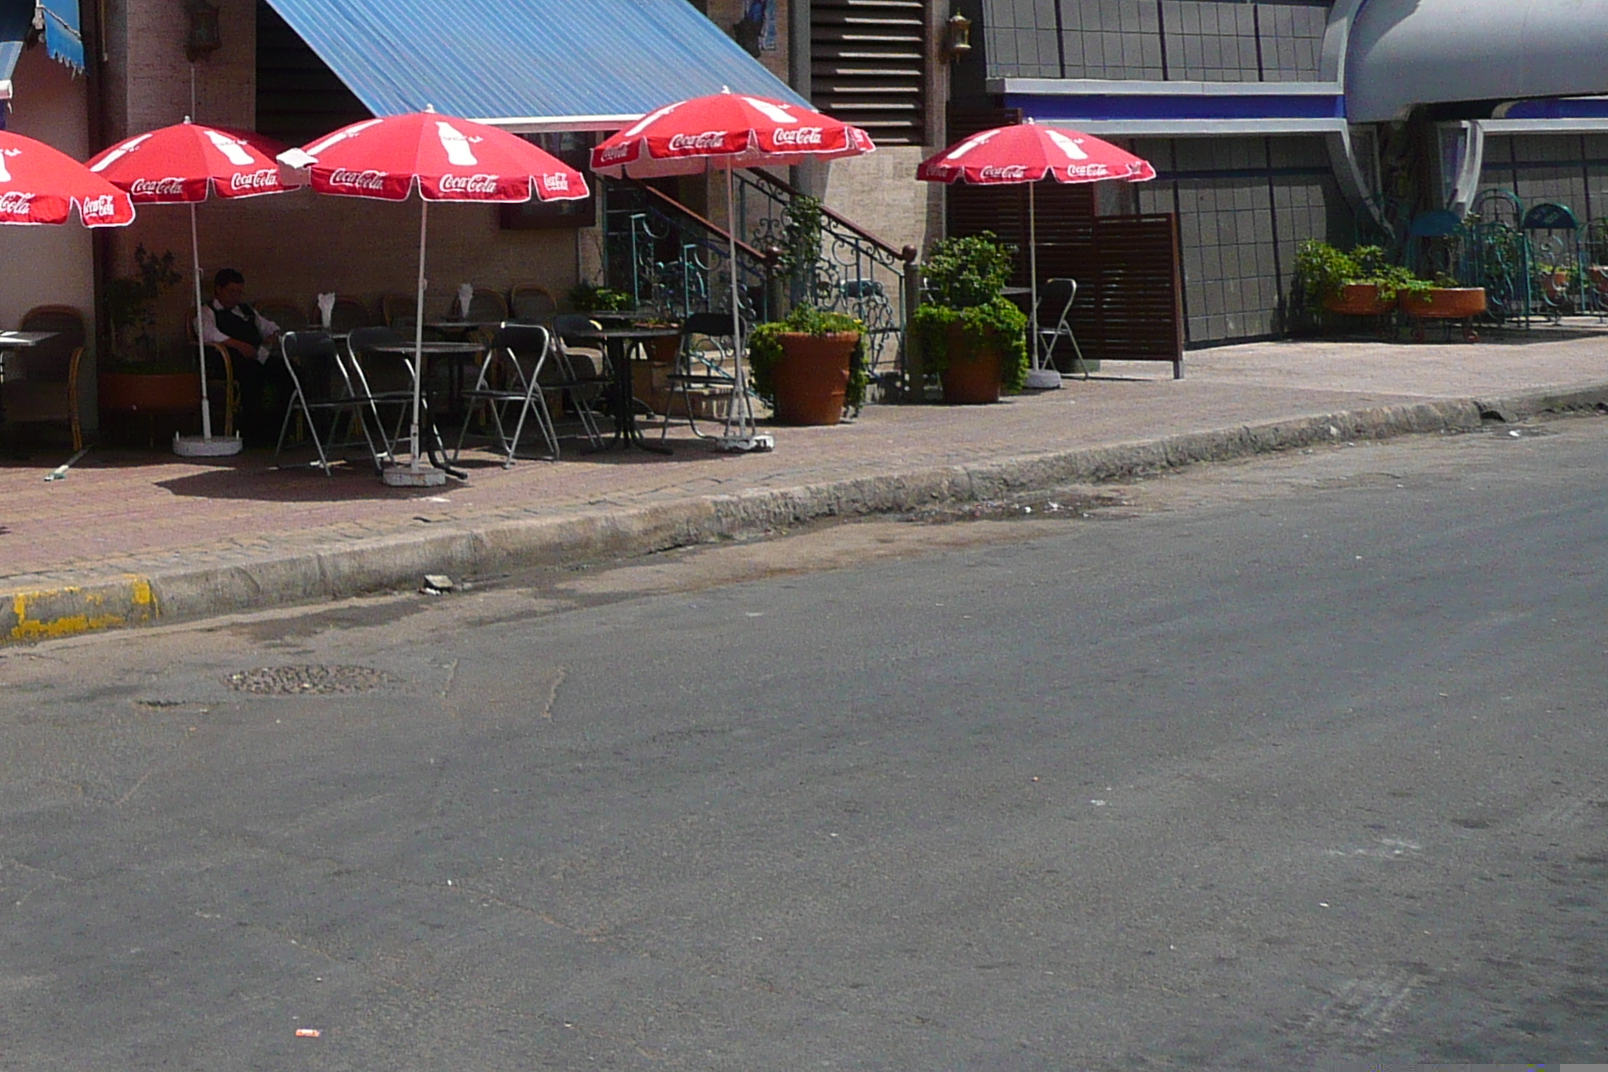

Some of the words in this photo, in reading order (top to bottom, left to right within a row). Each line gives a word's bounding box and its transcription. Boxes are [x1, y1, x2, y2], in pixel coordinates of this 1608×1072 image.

[669, 131, 728, 150] Coca-Cola
[773, 127, 823, 145] Coca-Cola
[231, 169, 278, 190] Coca-Cola
[330, 168, 390, 190] Coca-Cola
[980, 165, 1028, 178] Coca-Cola
[1067, 164, 1109, 177] Coca-Cola
[131, 177, 187, 195] Coca-Cola
[439, 173, 500, 193] Coca-Cola
